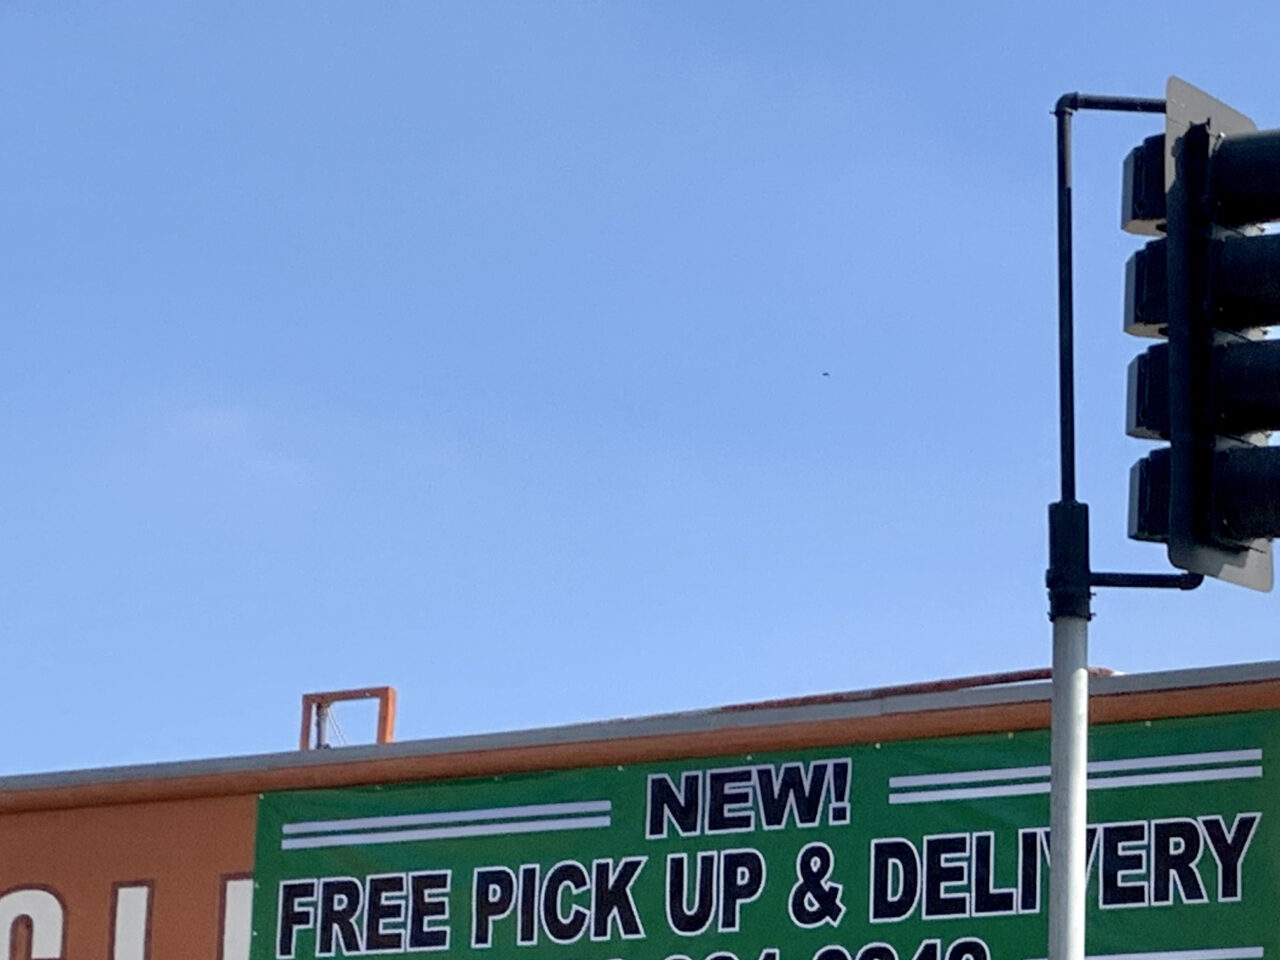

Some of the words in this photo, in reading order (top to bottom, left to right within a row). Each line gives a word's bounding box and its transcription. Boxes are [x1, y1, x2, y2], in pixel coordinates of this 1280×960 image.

[646, 757, 852, 840] NEW!
[276, 869, 452, 960] FREE
[471, 856, 648, 949] PICK
[666, 848, 766, 936] UP
[789, 842, 845, 929] &
